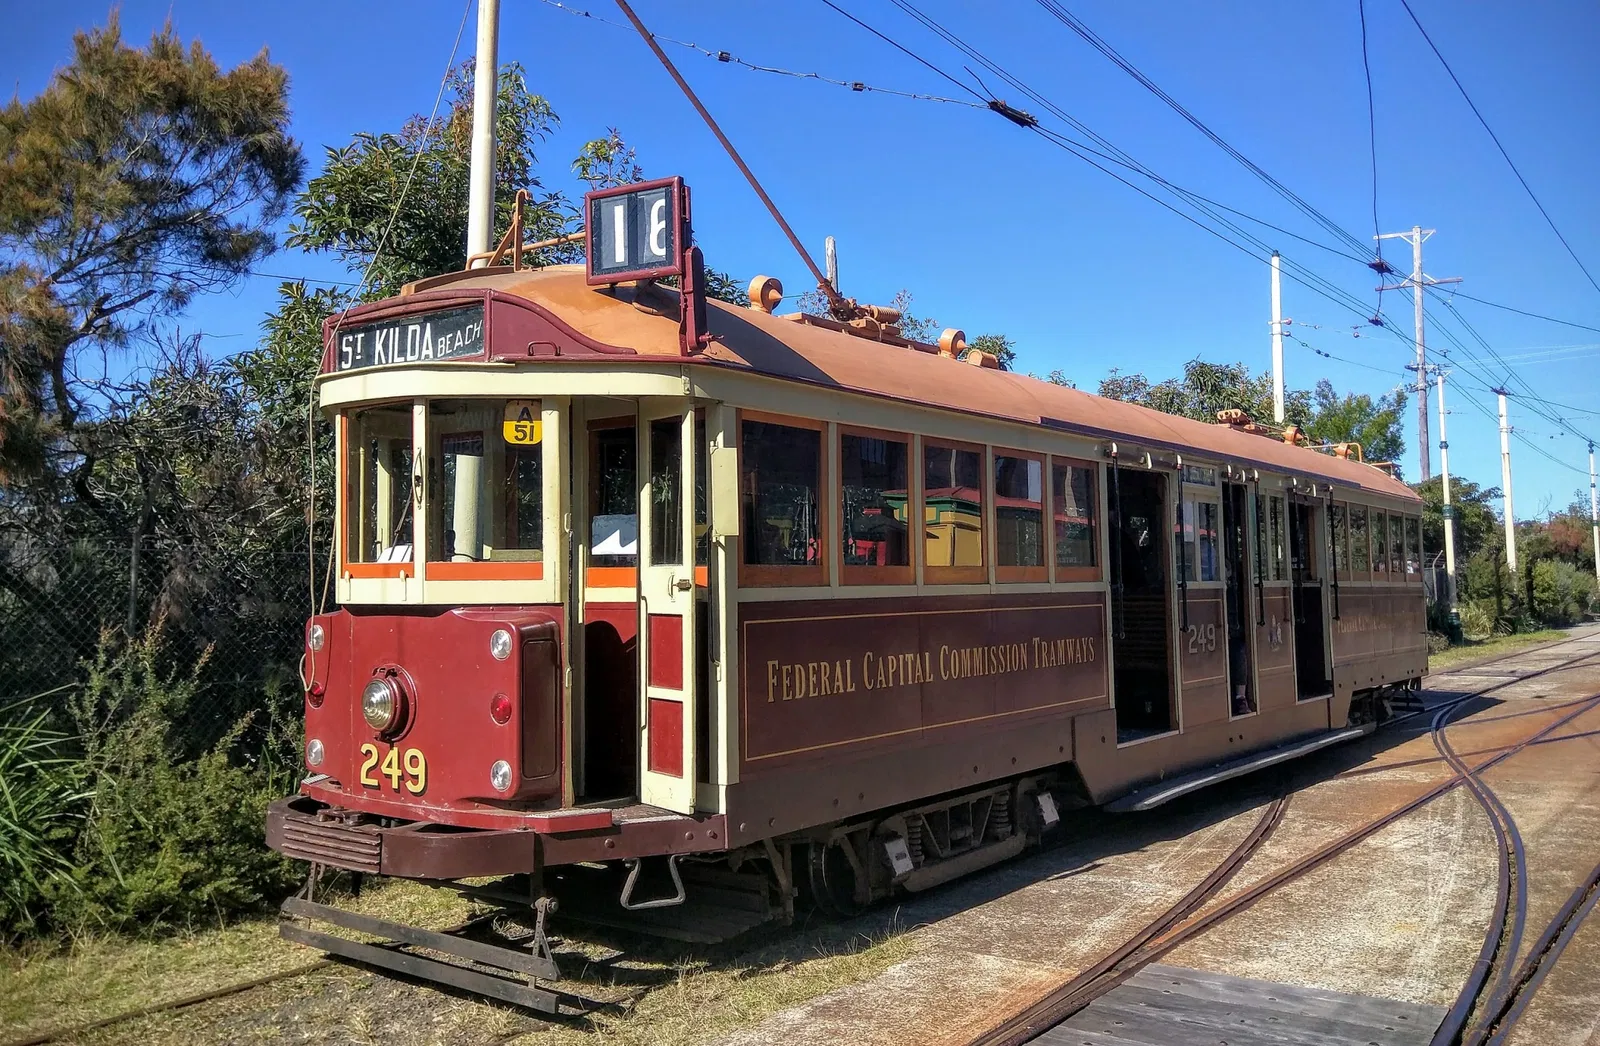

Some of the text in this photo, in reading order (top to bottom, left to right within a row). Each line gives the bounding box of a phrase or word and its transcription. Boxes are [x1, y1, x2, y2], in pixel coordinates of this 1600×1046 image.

[375, 322, 434, 365] KILDA
[437, 320, 483, 357] BEACH
[514, 424, 534, 442] 51
[517, 406, 534, 423] A
[1188, 623, 1216, 654] 249
[767, 637, 1095, 703] FEDERAL CAPITAL COMMISSION TRAMWAYS
[360, 743, 428, 797] 249
